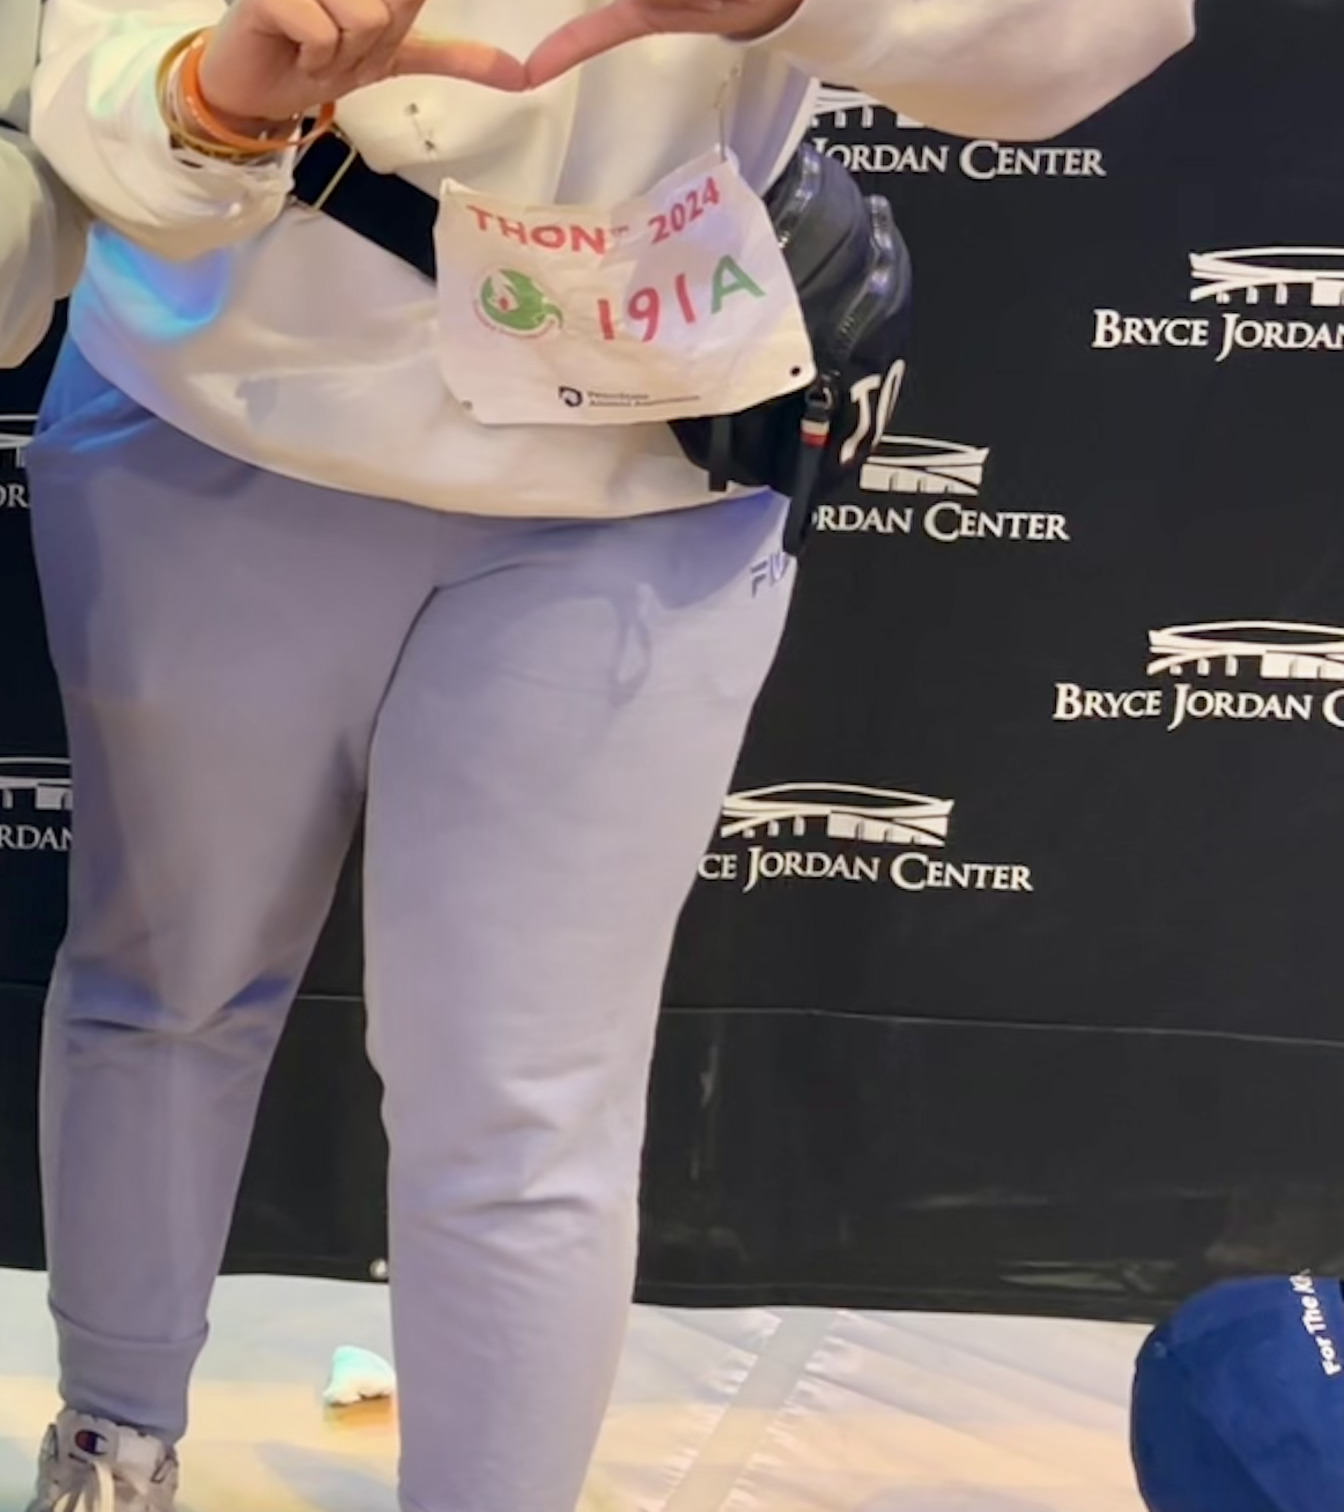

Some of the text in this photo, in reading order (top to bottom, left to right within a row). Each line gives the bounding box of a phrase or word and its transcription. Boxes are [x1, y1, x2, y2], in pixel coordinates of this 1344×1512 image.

[960, 140, 1107, 180] CENTER
[647, 176, 721, 244] 2024
[597, 254, 767, 342] 191A
[1091, 308, 1210, 349] BRYCE
[812, 501, 1071, 542] RDAN CENTER
[1052, 682, 1163, 721] BRYCE
[1167, 683, 1313, 732] JORDAN
[742, 846, 881, 893] JORDAN
[890, 852, 1034, 892] CENTER
[1302, 1295, 1327, 1335] The
[1314, 1335, 1342, 1376] For
